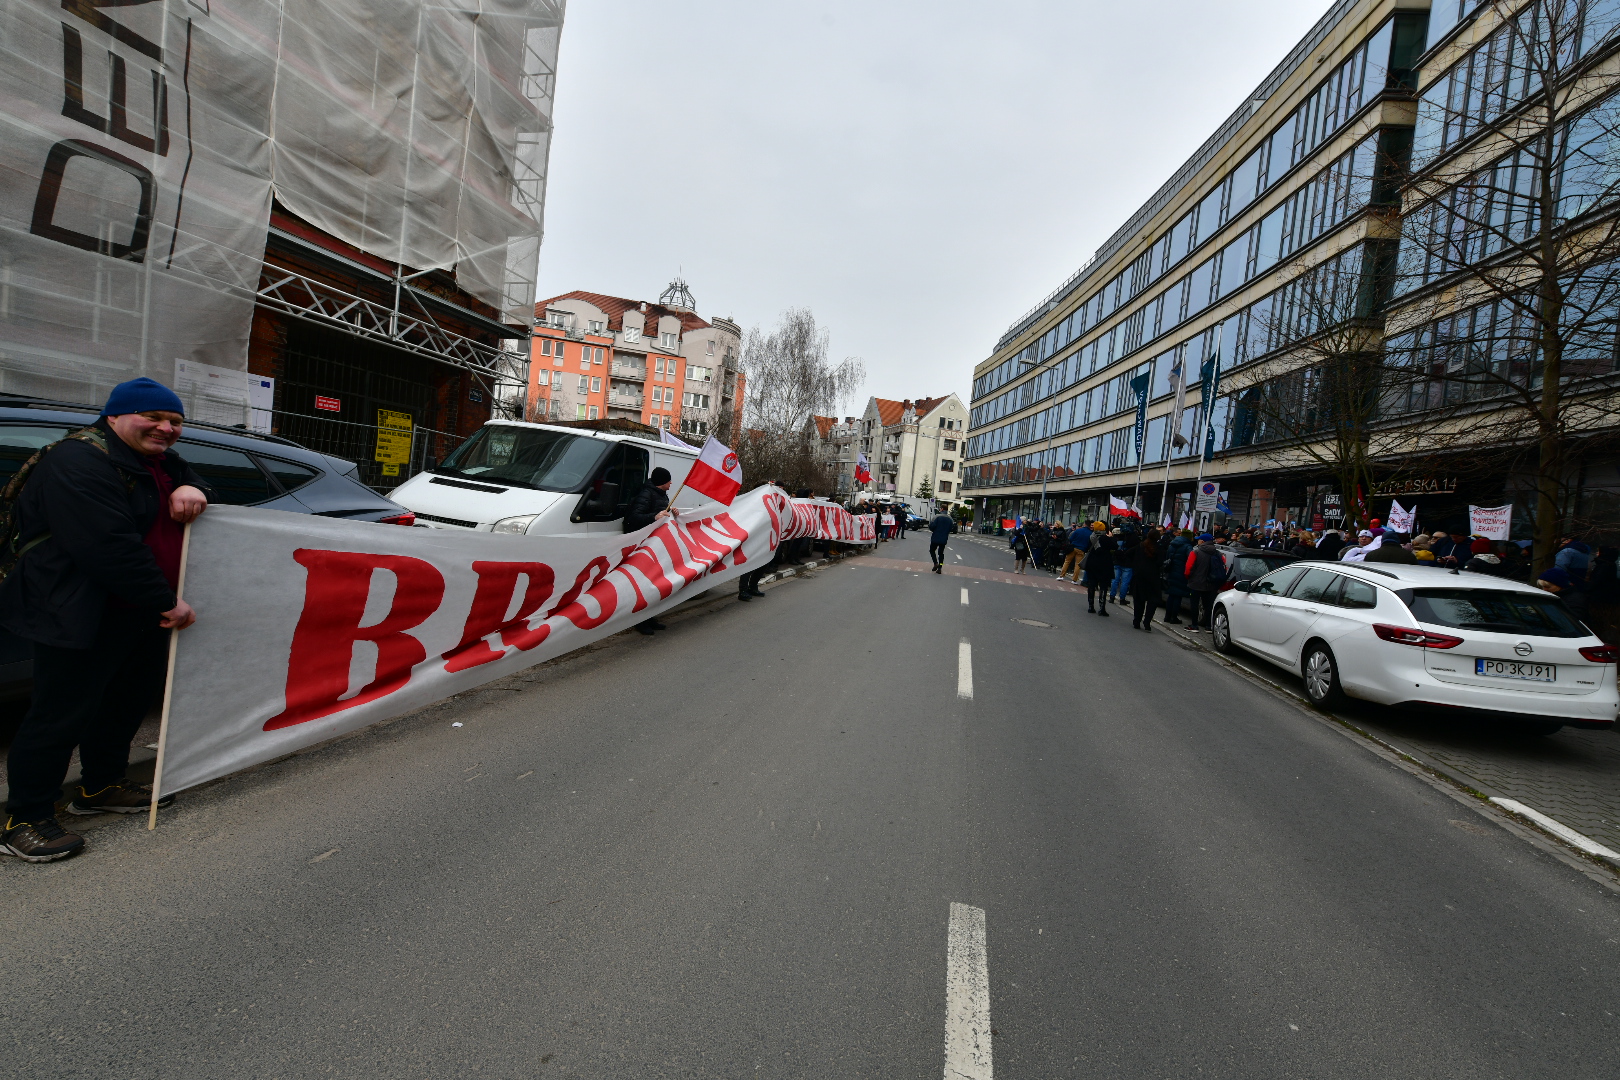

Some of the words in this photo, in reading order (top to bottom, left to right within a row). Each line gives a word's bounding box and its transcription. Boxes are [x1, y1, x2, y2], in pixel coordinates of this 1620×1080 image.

[1443, 477, 1458, 491] 14
[263, 511, 749, 732] BRONIMY
[1486, 661, 1504, 674] PO
[1509, 663, 1550, 678] 3KJ91
